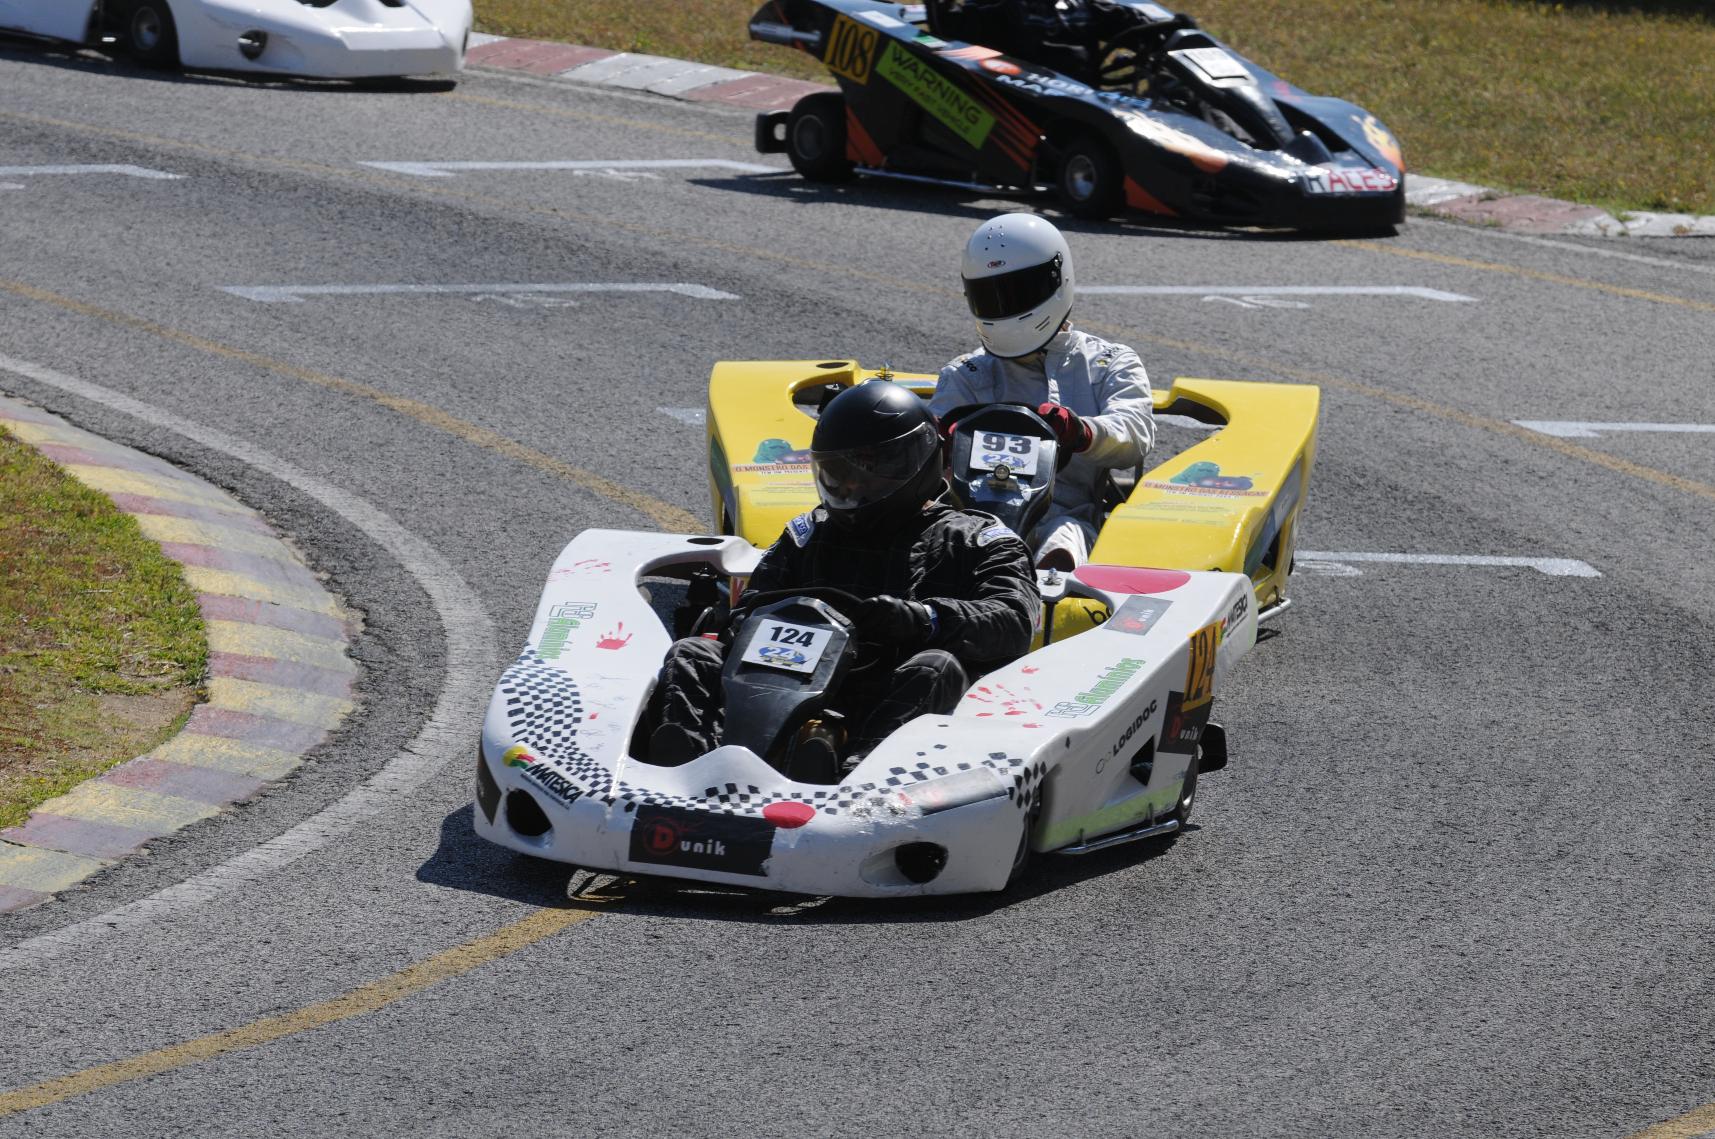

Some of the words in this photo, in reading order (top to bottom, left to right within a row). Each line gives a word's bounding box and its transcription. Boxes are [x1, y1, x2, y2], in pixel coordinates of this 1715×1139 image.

[829, 19, 875, 78] 108
[891, 43, 982, 126] WARNING
[982, 433, 1032, 454] 93
[770, 626, 815, 648] 124
[1184, 626, 1216, 702] 124
[1112, 699, 1158, 757] LOGIDOC
[652, 823, 727, 857] Dunik
